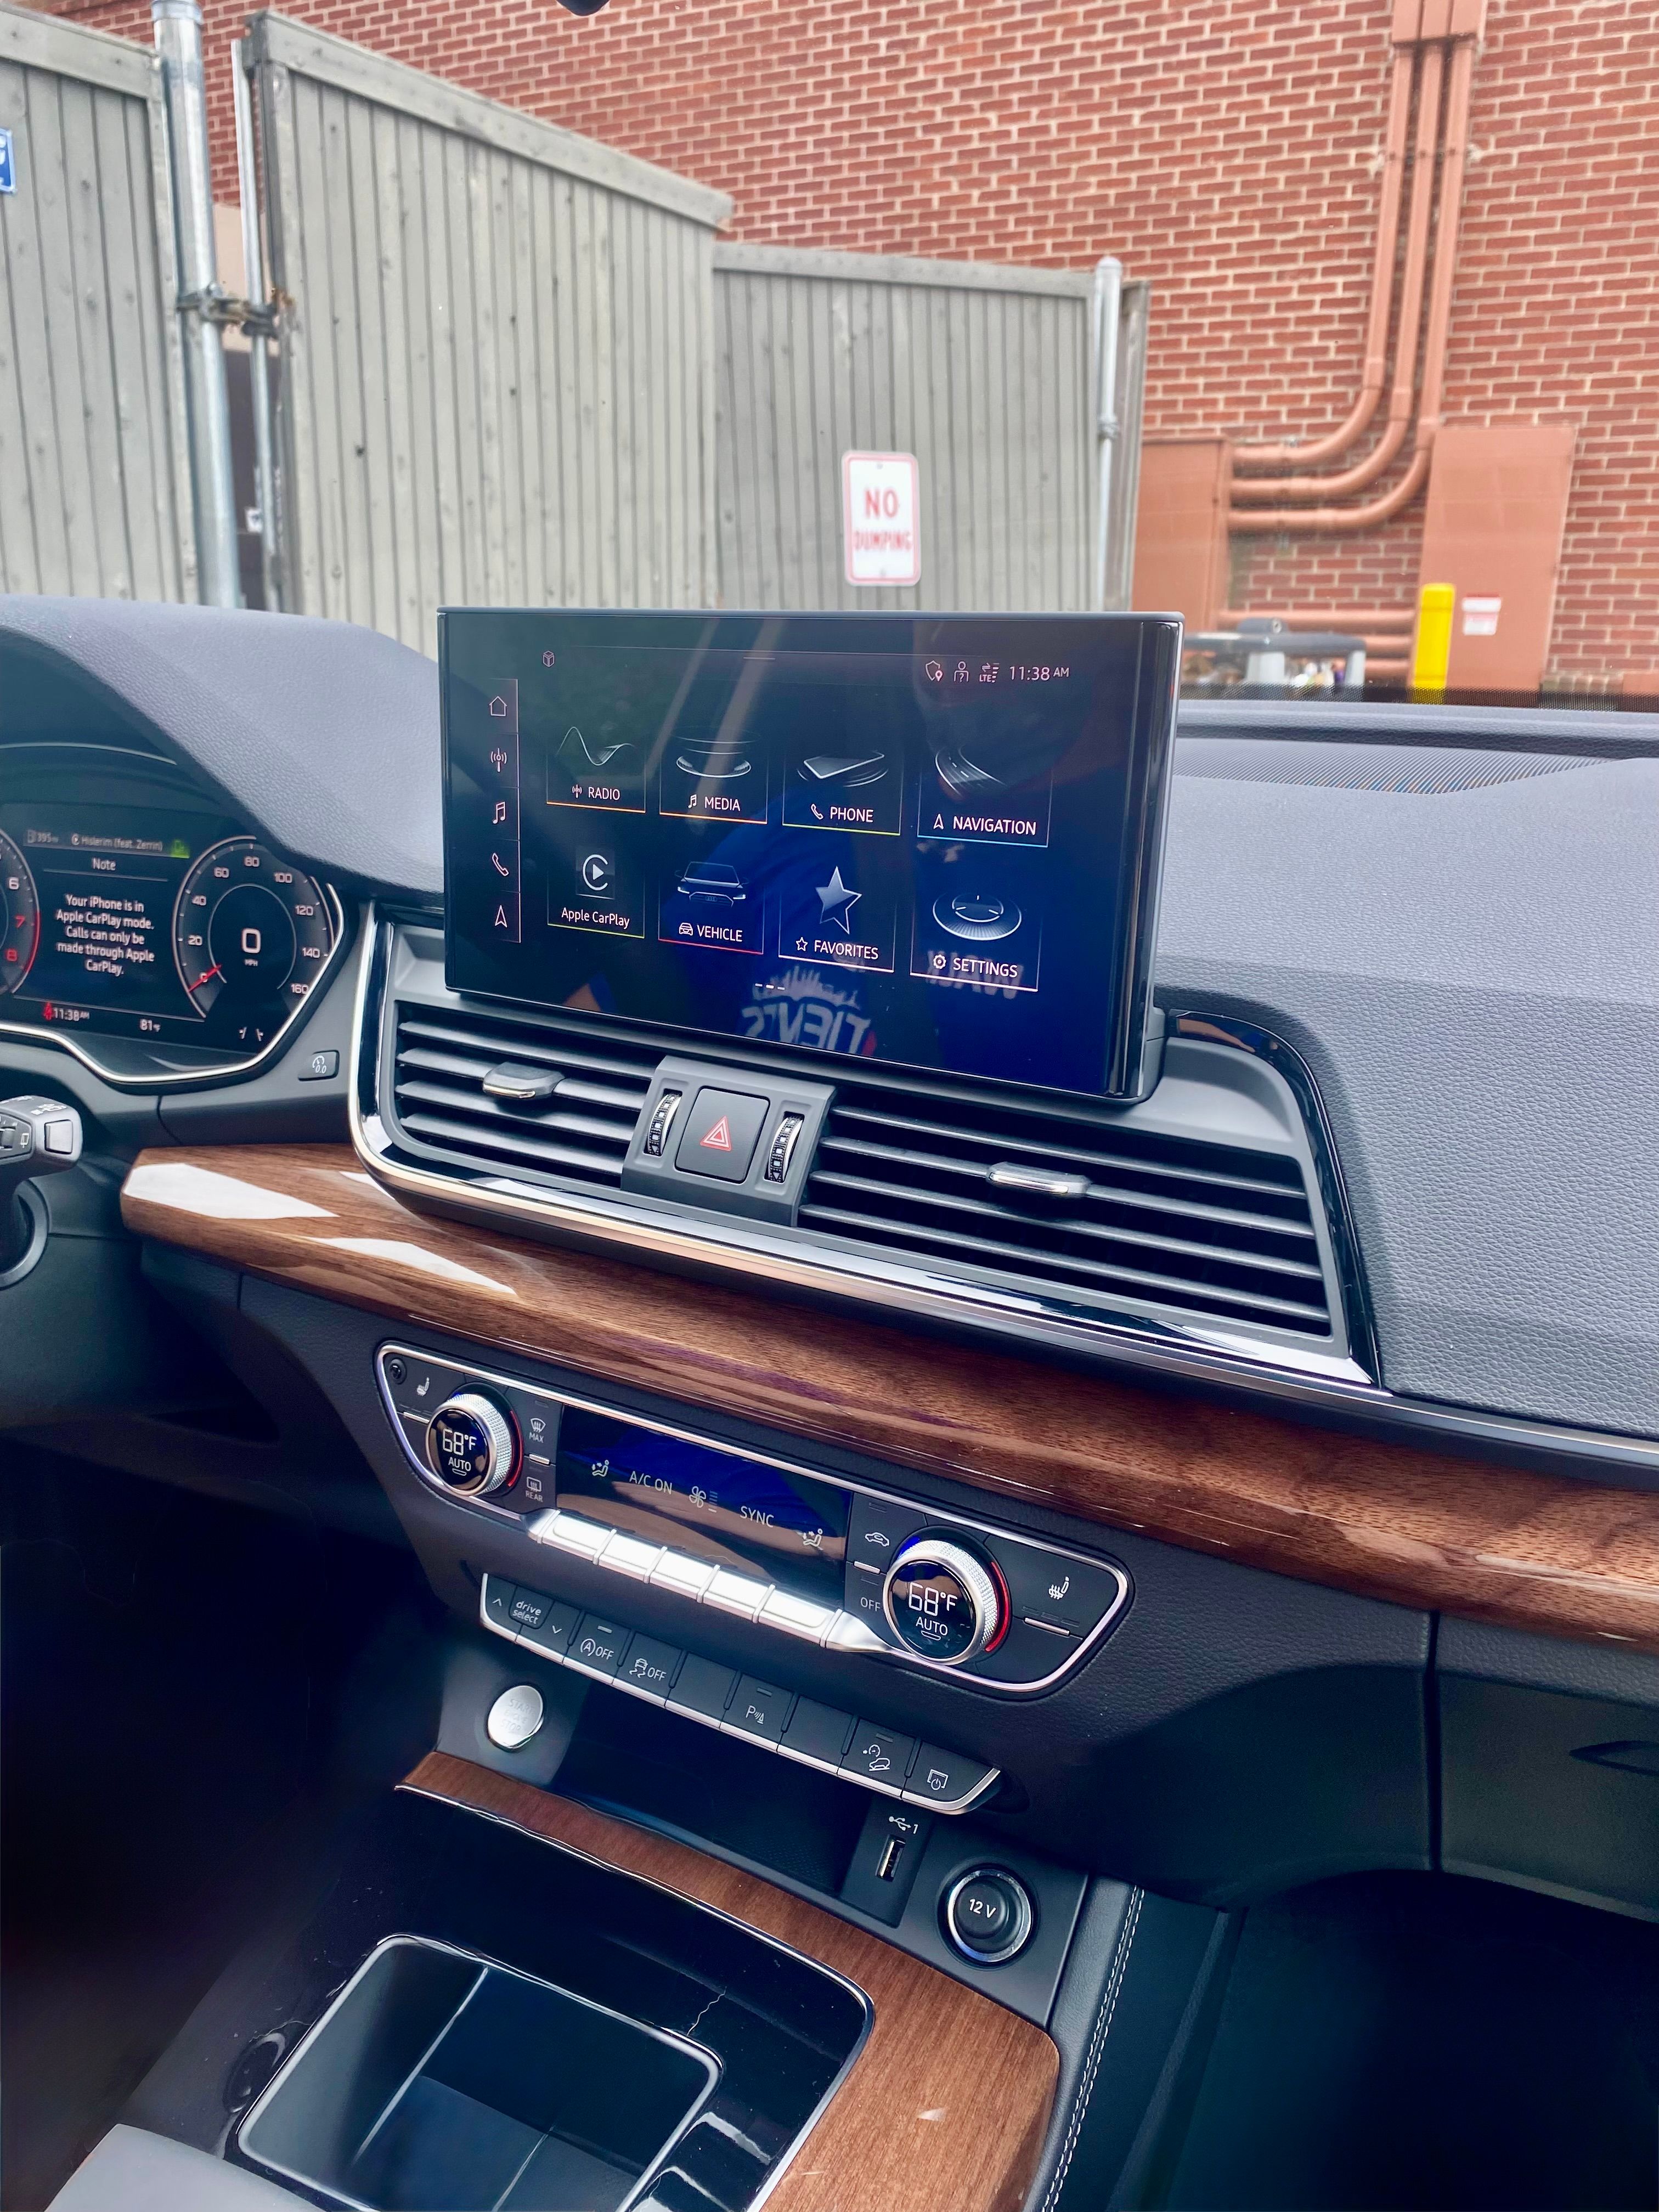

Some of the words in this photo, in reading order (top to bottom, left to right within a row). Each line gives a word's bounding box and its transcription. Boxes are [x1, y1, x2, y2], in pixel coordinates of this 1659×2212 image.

[865, 487, 899, 518] NO
[1009, 665, 1050, 681] 11:38
[1053, 667, 1069, 678] AM
[588, 786, 620, 800] RADIO
[704, 795, 741, 811] MEDIA
[830, 806, 874, 823] PHONE
[953, 816, 1036, 836] NAVIGATION
[92, 857, 116, 871] Note
[244, 856, 259, 867] 80
[214, 866, 229, 878] 60
[275, 872, 292, 884] 100
[8, 877, 19, 890] 6
[66, 894, 88, 907] Your
[89, 896, 122, 910] iPhone
[125, 899, 133, 911] is
[135, 900, 144, 912] in
[192, 895, 207, 906] 40
[295, 905, 314, 916] 120
[561, 907, 590, 923] Apple
[592, 911, 630, 929] CarPlay
[15, 915, 26, 928] 7
[57, 909, 83, 924] Apple
[86, 911, 122, 929] CarPlay
[123, 916, 154, 930] mode.
[66, 925, 89, 939] Calls
[91, 930, 108, 941] can
[110, 931, 131, 946] only
[132, 932, 145, 945] be
[188, 934, 202, 946] 20
[241, 928, 261, 953] 0
[696, 924, 743, 942] VEHICLE
[6, 949, 18, 962] 8
[57, 942, 83, 954] made
[86, 944, 124, 960] through
[126, 948, 155, 963] Apple
[302, 947, 320, 958] 140
[814, 940, 878, 960] FAVORITES
[86, 959, 124, 977] CarPlay.
[953, 957, 1018, 978] SETTINGS
[291, 983, 309, 995] 160
[53, 1007, 80, 1022] 11:38
[529, 1432, 545, 1443] MAX
[448, 1457, 471, 1472] AUTO
[629, 1470, 651, 1488] A/C
[654, 1477, 673, 1495] ON
[526, 1491, 543, 1503] REAR
[740, 1505, 774, 1528] SYNC
[516, 1600, 541, 1616] drive
[860, 1596, 881, 1612] OFF
[512, 1609, 539, 1624] select
[916, 1616, 949, 1637] AUTO
[595, 1646, 614, 1660] OFF
[647, 1667, 667, 1681] OFF
[912, 1824, 918, 1834] 1
[969, 1898, 984, 1914] 12
[986, 1904, 996, 1918] V
